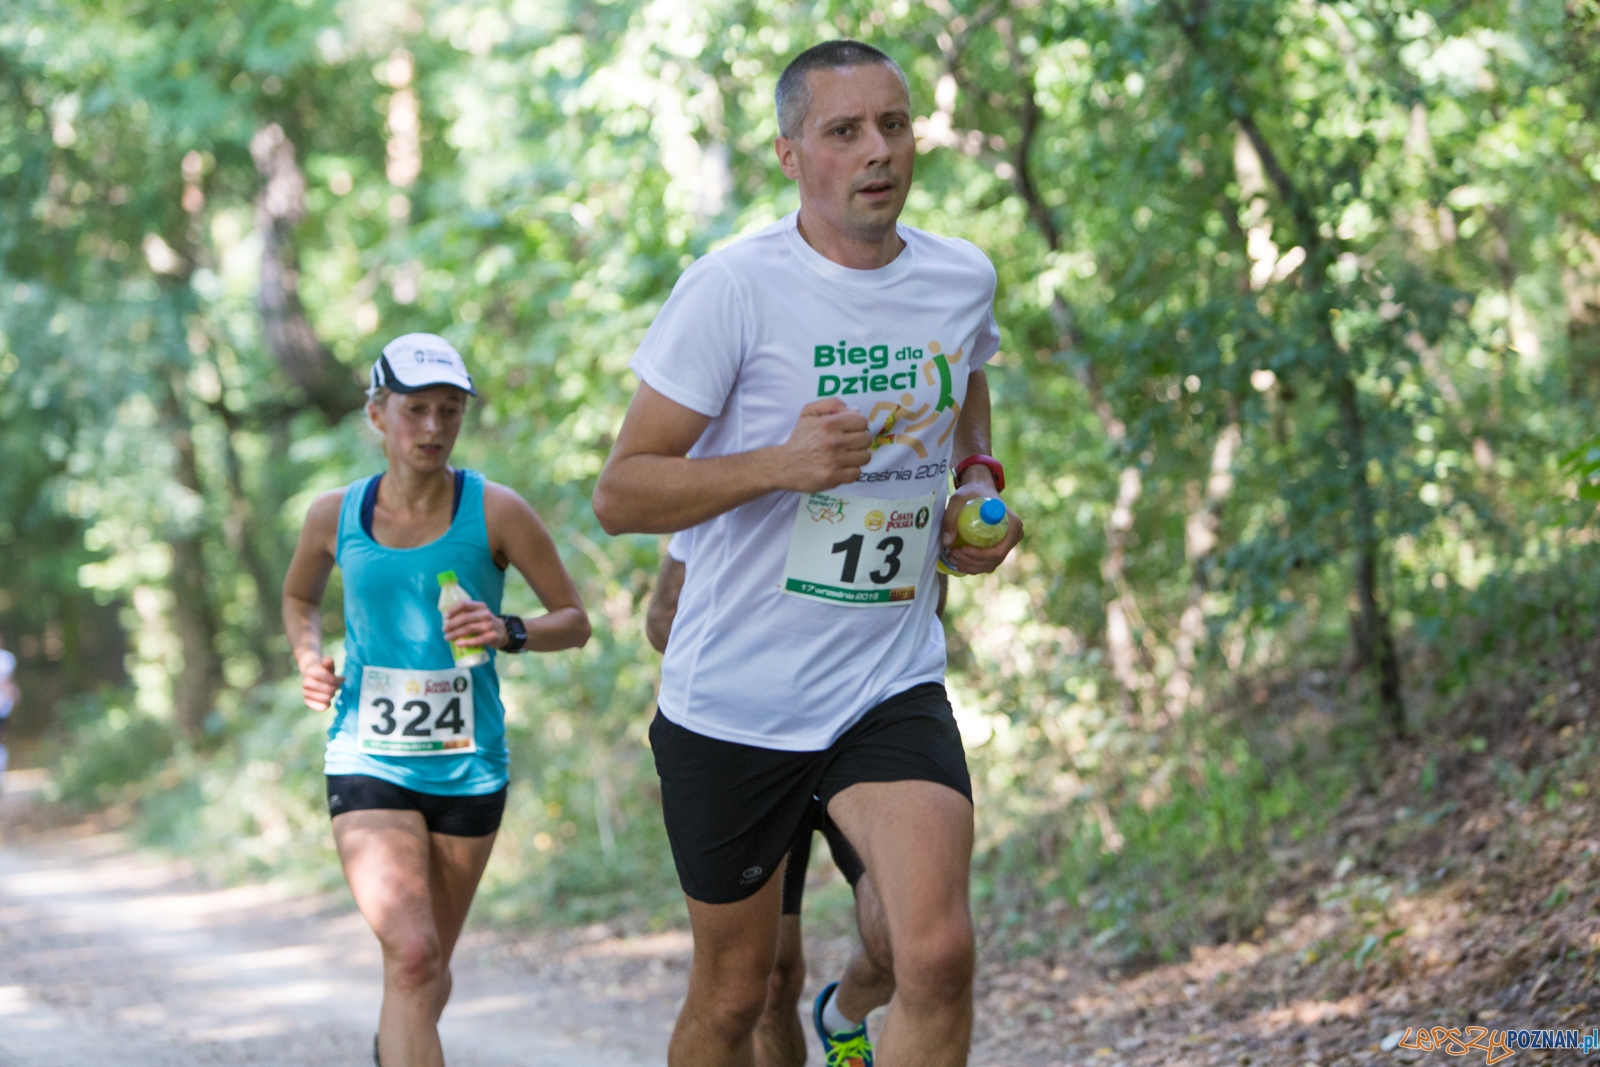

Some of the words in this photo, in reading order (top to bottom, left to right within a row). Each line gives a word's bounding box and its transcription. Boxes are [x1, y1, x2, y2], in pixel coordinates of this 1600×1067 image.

[813, 340, 888, 369] Bieg
[895, 346, 923, 361] dla
[817, 364, 917, 397] Dzieci
[855, 466, 912, 483] ześnia
[831, 533, 904, 584] 13
[371, 697, 465, 736] 324
